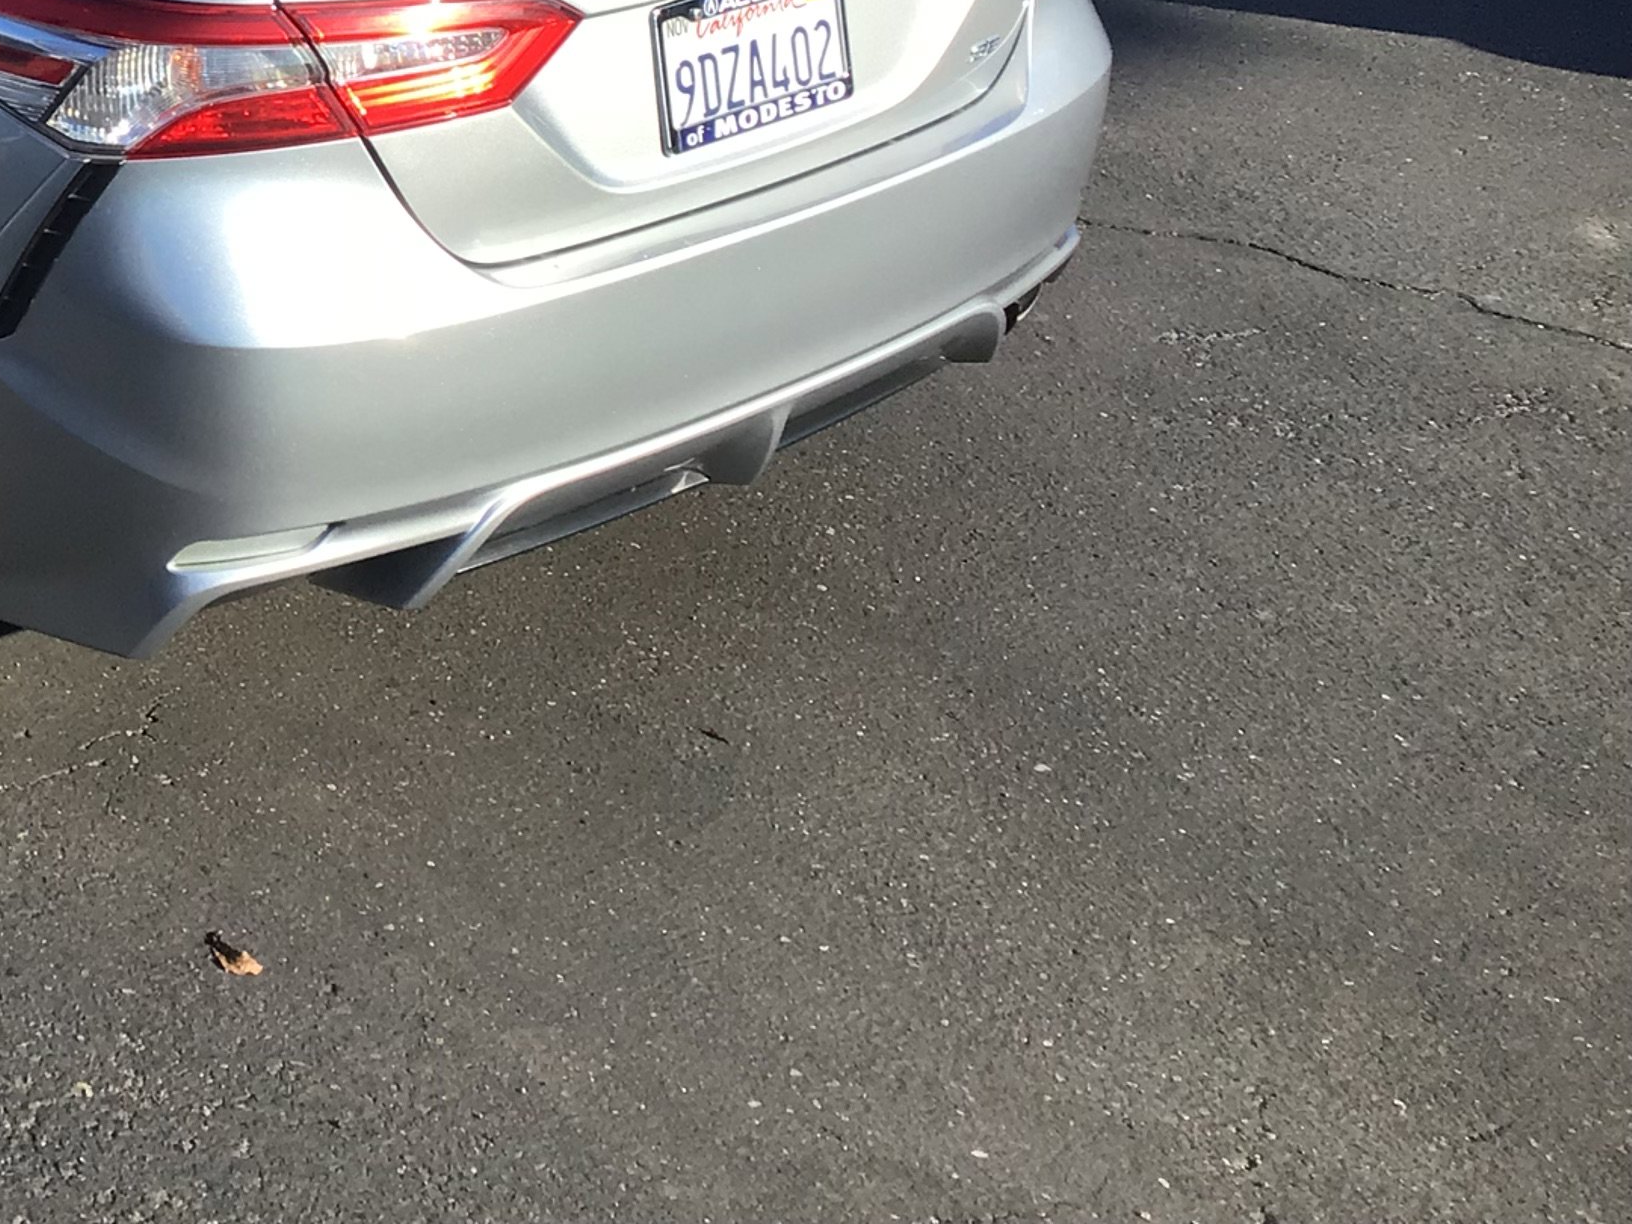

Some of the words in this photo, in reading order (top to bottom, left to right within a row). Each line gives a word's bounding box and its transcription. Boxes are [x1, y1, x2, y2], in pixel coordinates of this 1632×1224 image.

[675, 19, 837, 127] 9DZA402
[686, 125, 705, 147] of
[714, 80, 847, 139] MODESTO
